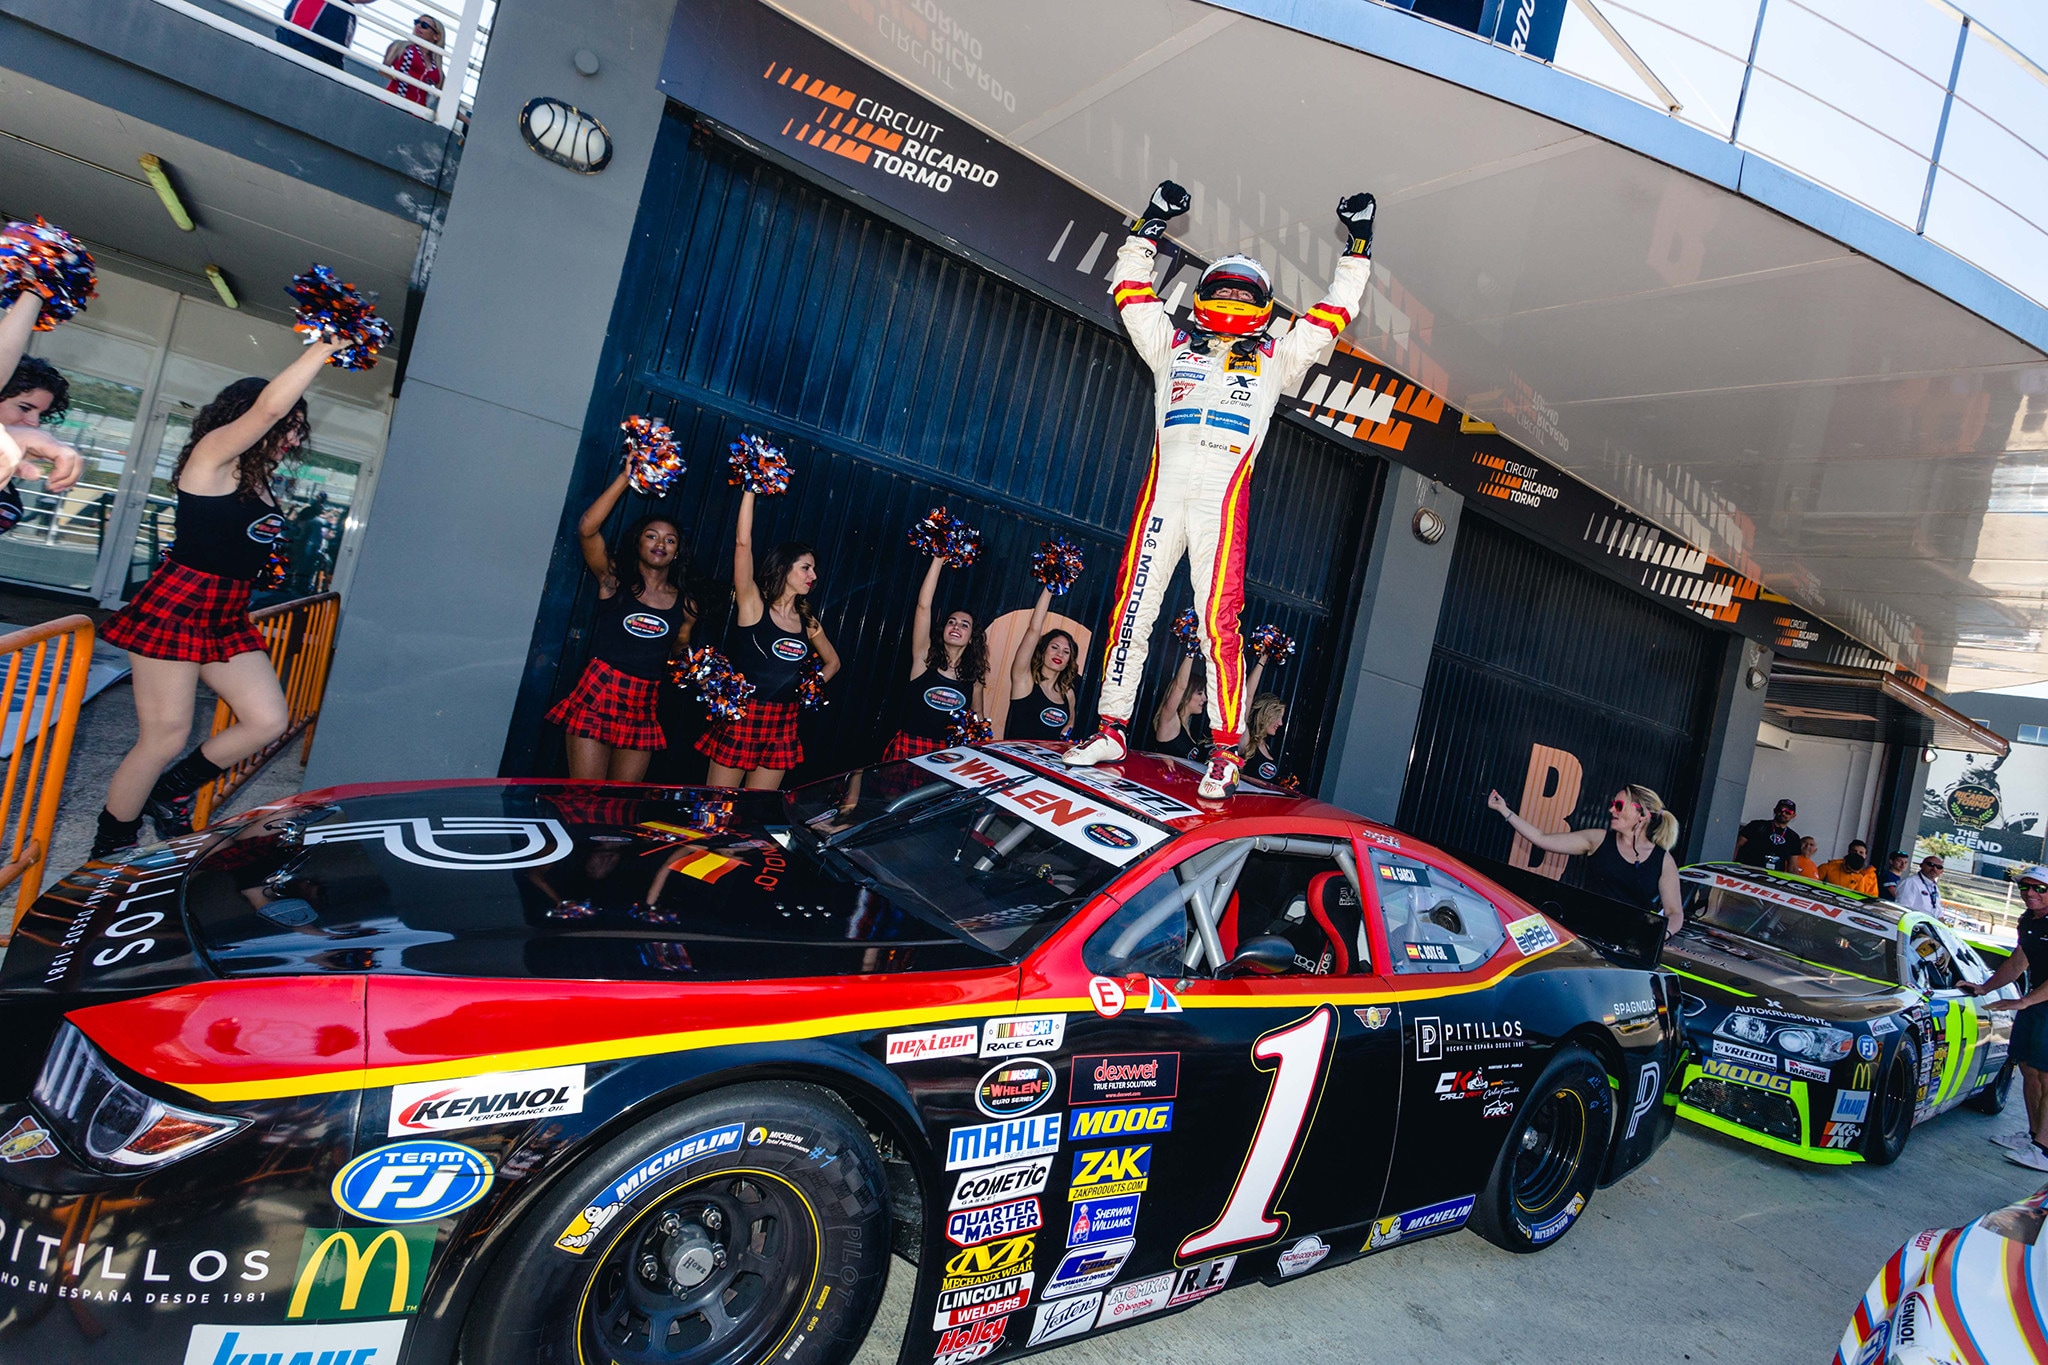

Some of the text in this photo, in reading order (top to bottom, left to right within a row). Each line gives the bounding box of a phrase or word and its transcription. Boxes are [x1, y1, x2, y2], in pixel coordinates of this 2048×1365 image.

[855, 98, 944, 143] CIRCUIT
[873, 150, 952, 192] TORMO
[902, 138, 999, 188] RICARDO
[1504, 461, 1538, 479] CIRCUIT
[1510, 490, 1540, 507] TORMO
[1521, 480, 1559, 499] RICARDO
[1112, 555, 1152, 687] MOTORSPORT
[950, 757, 1097, 826] WHLEN
[1954, 791, 1995, 804] RICARDO
[1957, 798, 1991, 809] TORMO
[1935, 831, 2003, 853] LEGEND
[1957, 828, 1980, 839] THE
[1715, 875, 1843, 918] WHELEN
[61, 909, 96, 947] DESDE
[44, 950, 74, 983] 1981
[1096, 983, 1117, 1007] E
[1614, 999, 1656, 1015] SPAGNOLO
[1014, 1020, 1052, 1036] NASCAR
[1445, 1020, 1522, 1041] PITILLOS
[889, 1033, 974, 1057] nexteer
[986, 1039, 1054, 1051] RACE CAR
[1724, 1045, 1776, 1064] VRIENDS
[1862, 1042, 1873, 1056] FJ
[1094, 1059, 1158, 1081] dexwet
[1703, 1059, 1790, 1092] MOOG
[1789, 1067, 1827, 1081] MAGNUS
[990, 1080, 1042, 1097] WHELEN
[1108, 1081, 1126, 1089] FILTER
[1127, 1080, 1156, 1088] SOLUTIONS
[410, 1086, 570, 1122] KENNOL
[992, 1096, 1034, 1106] EURO SERIES
[1837, 1092, 1866, 1120] KNAUF
[468, 1107, 545, 1122] PERFORMANCE
[1072, 1106, 1170, 1137] MOOG
[769, 1131, 803, 1144] MICHELIN
[949, 1116, 1060, 1163] MAHLE
[1178, 1007, 1332, 1259] 1
[384, 1152, 465, 1164] TEAM
[616, 1130, 739, 1200] MICHELIN
[1072, 1145, 1151, 1186] ZAK
[358, 1165, 462, 1209] FJ
[957, 1165, 1046, 1200] COMETIC
[1073, 1181, 1143, 1199] ZAKPRODUCTS.COM
[950, 1200, 1036, 1236] QUARTER
[1092, 1217, 1131, 1232] WILLIAMS
[1094, 1206, 1133, 1220] SHERWIN
[1406, 1204, 1472, 1231] MICHELIN
[964, 1213, 1038, 1243] MASTER
[1535, 1215, 1568, 1240] MICHELIN
[942, 1259, 1032, 1290] MECHANIX WEAR
[28, 1281, 49, 1294] EN
[58, 1286, 133, 1303] ESPAÑA
[145, 1293, 210, 1304] DESDE
[223, 1292, 266, 1303] 1981
[942, 1280, 1017, 1310] LINCOLN
[1125, 1298, 1153, 1311] brembo
[958, 1297, 1020, 1322] WELDERS
[1901, 1294, 1916, 1345] KENNOL
[934, 1316, 1009, 1357] Holley
[933, 1342, 994, 1365] MSD
